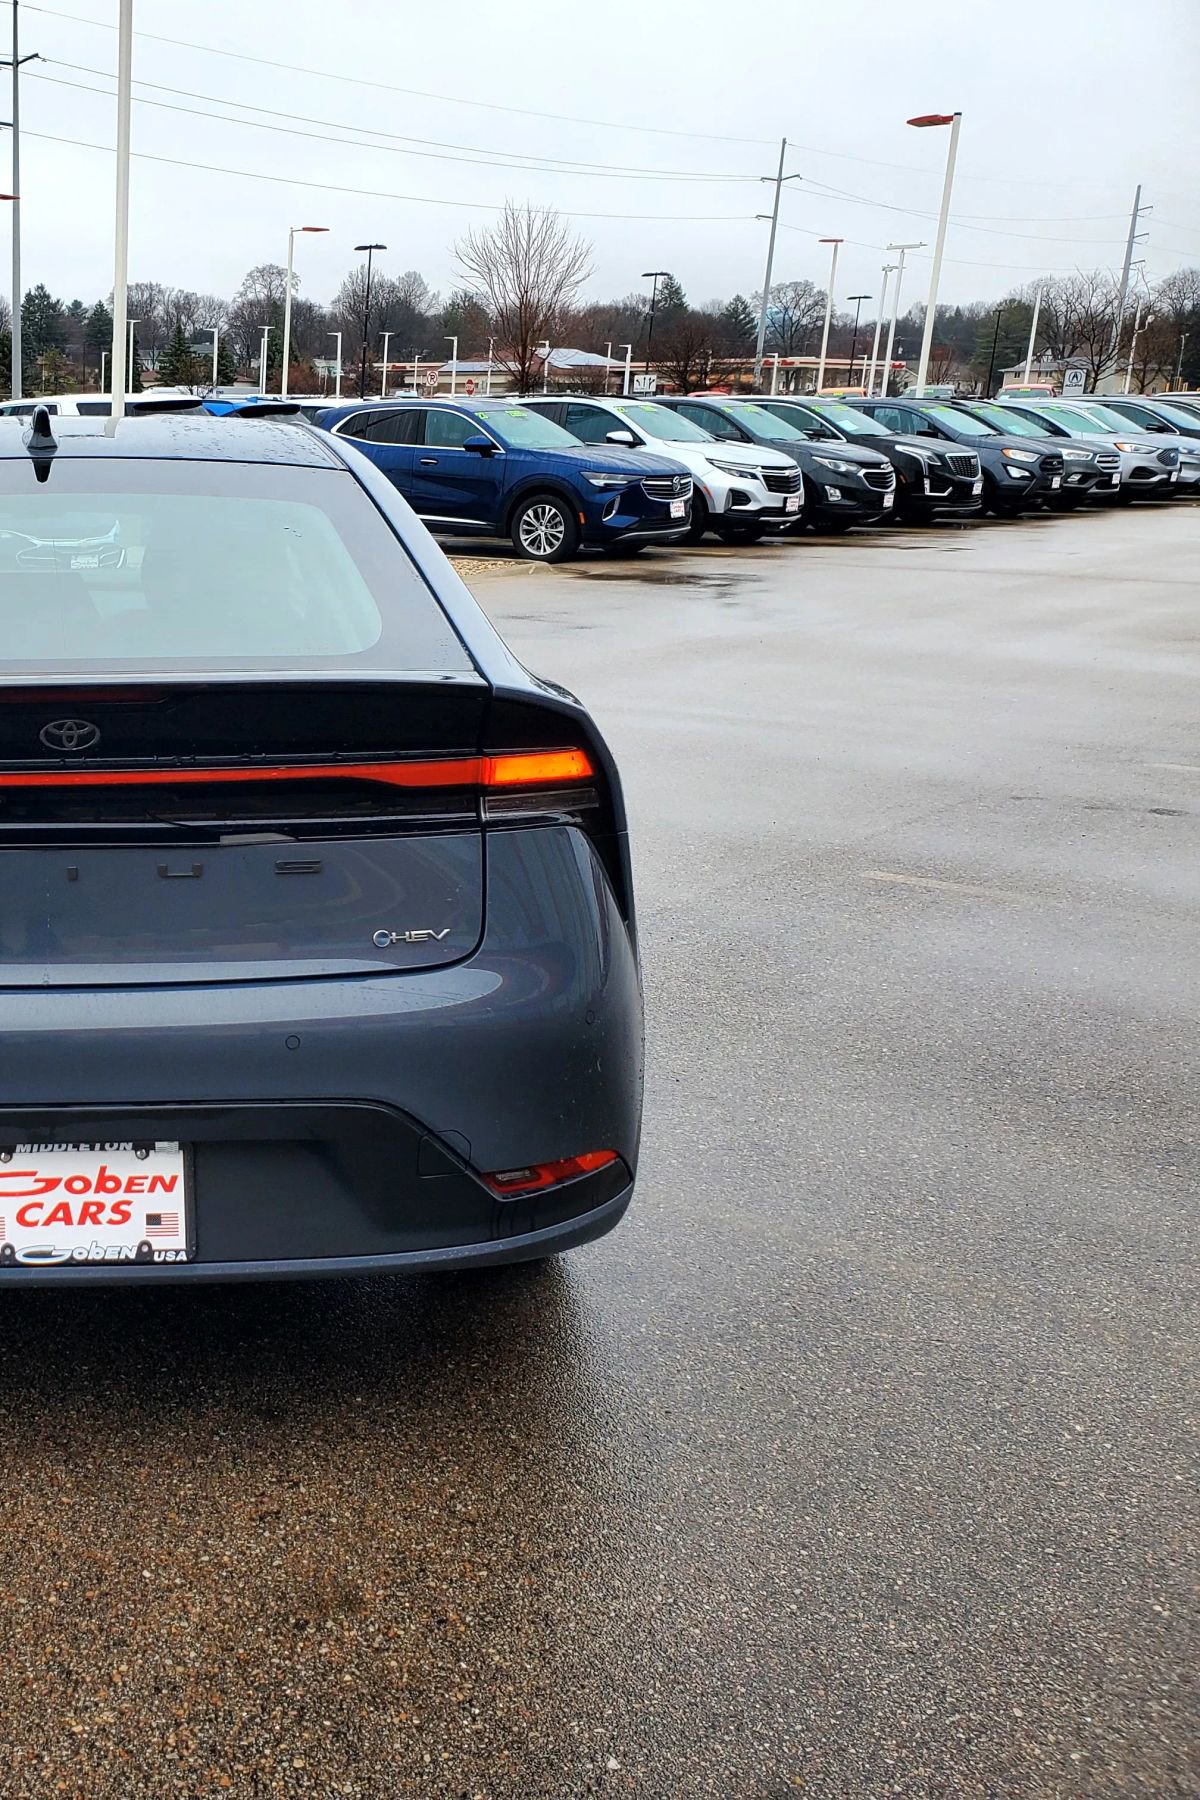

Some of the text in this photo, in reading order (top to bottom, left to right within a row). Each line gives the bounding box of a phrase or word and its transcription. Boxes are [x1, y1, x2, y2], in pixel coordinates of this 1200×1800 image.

[15, 1142, 133, 1154] MIDDLETON
[16, 1199, 134, 1228] CARS
[153, 1248, 188, 1262] USA
